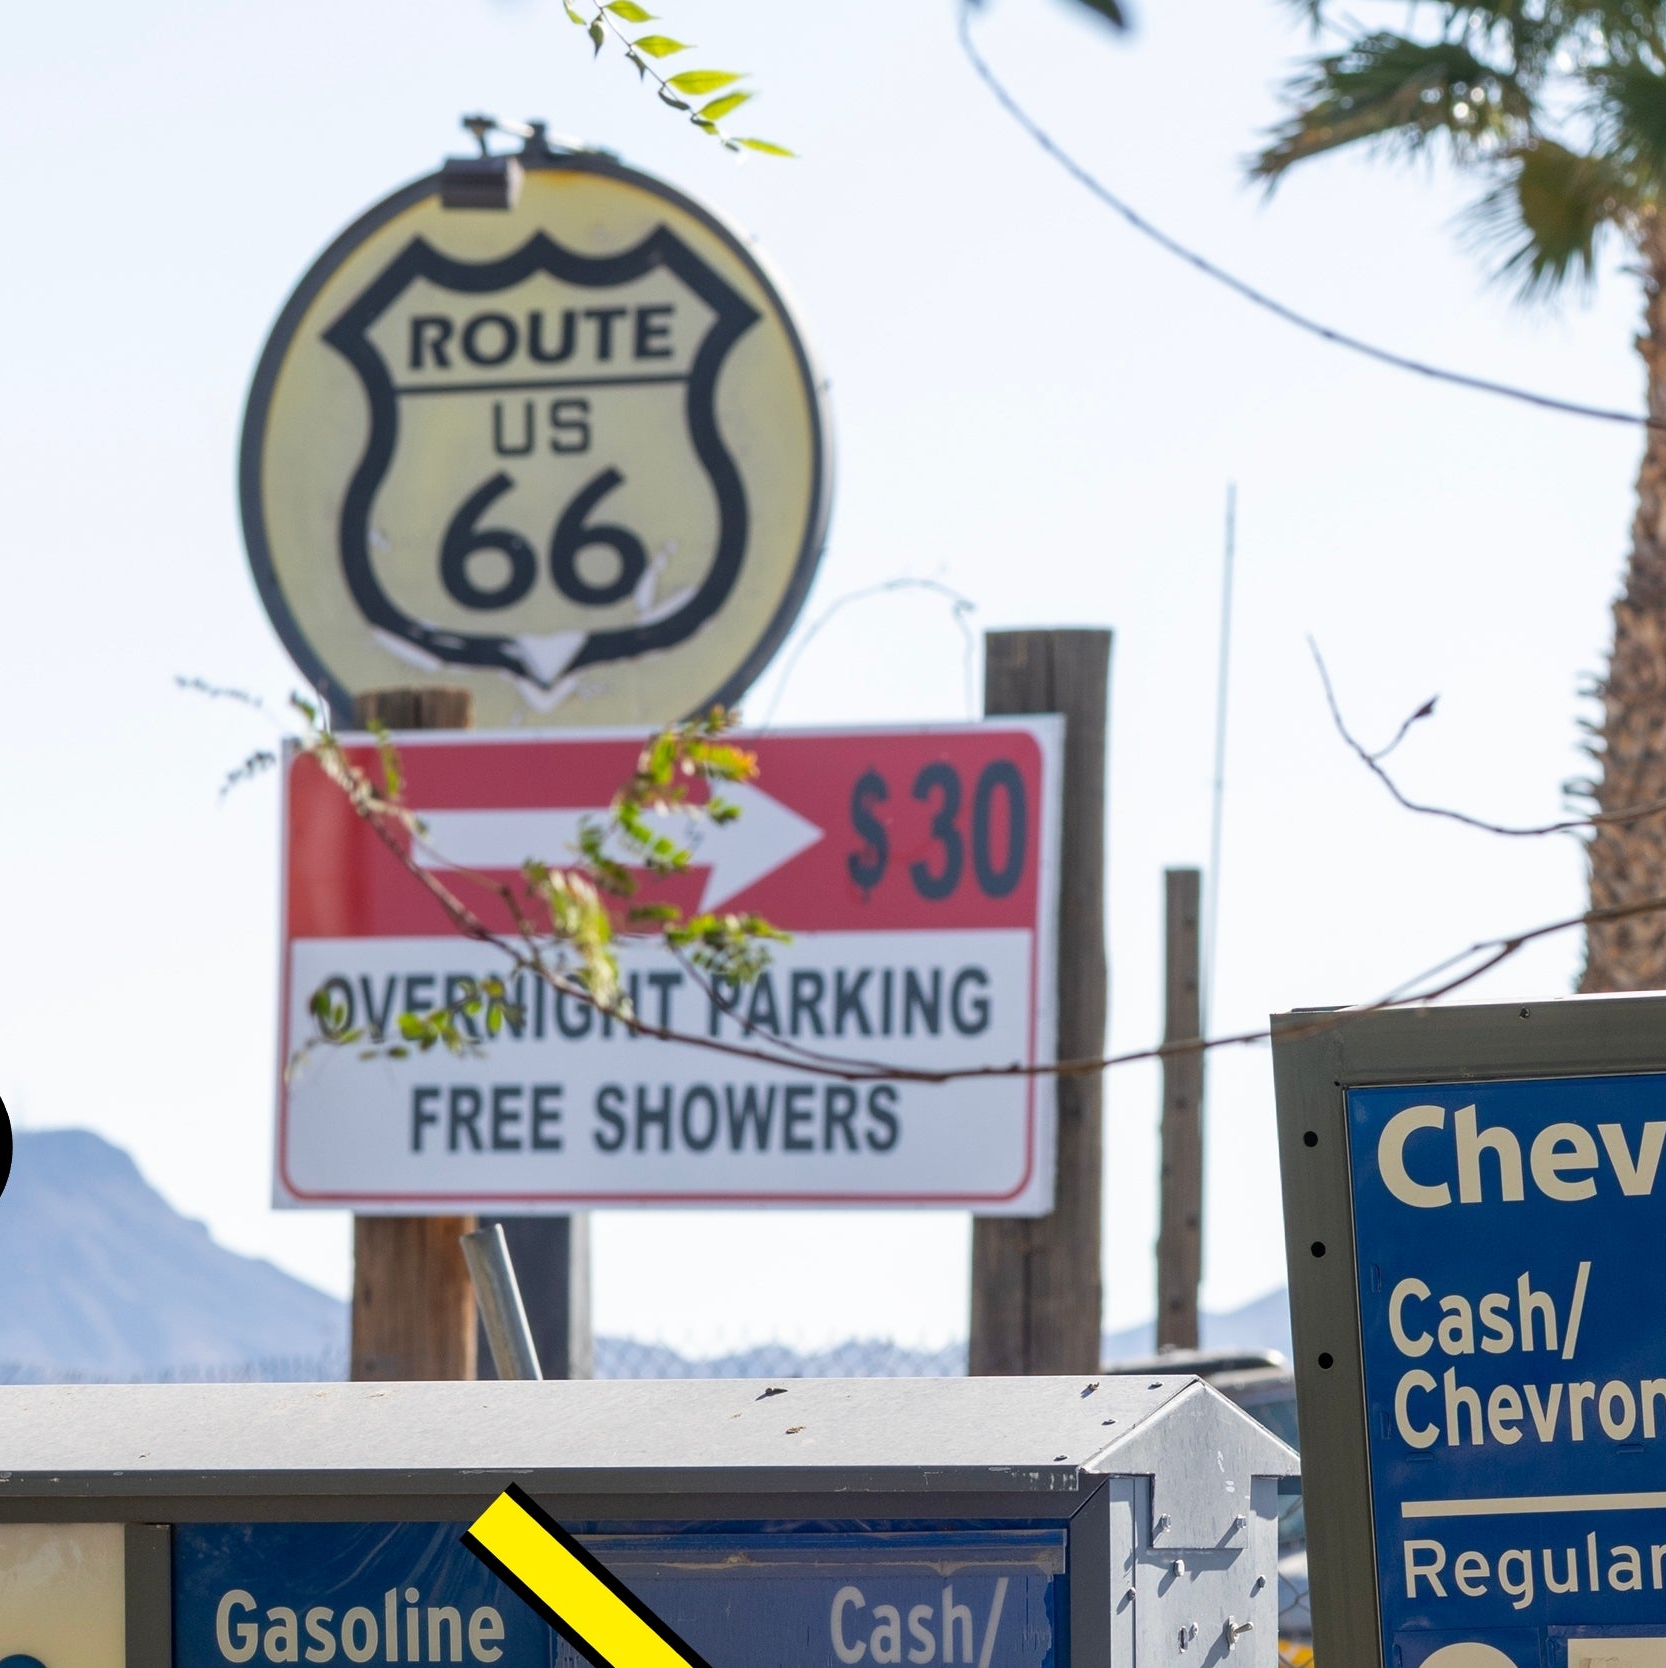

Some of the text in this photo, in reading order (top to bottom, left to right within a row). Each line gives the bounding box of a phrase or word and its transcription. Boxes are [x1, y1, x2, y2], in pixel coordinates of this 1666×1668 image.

[410, 305, 674, 369] ROUTE
[494, 399, 592, 456] US
[441, 468, 649, 610] 66
[847, 760, 1027, 902] $30
[713, 966, 990, 1038] PARKING
[411, 1084, 899, 1154] FREE SHOWERS
[1390, 1262, 1589, 1358] Cash/
[215, 1587, 506, 1665] Gasoline
